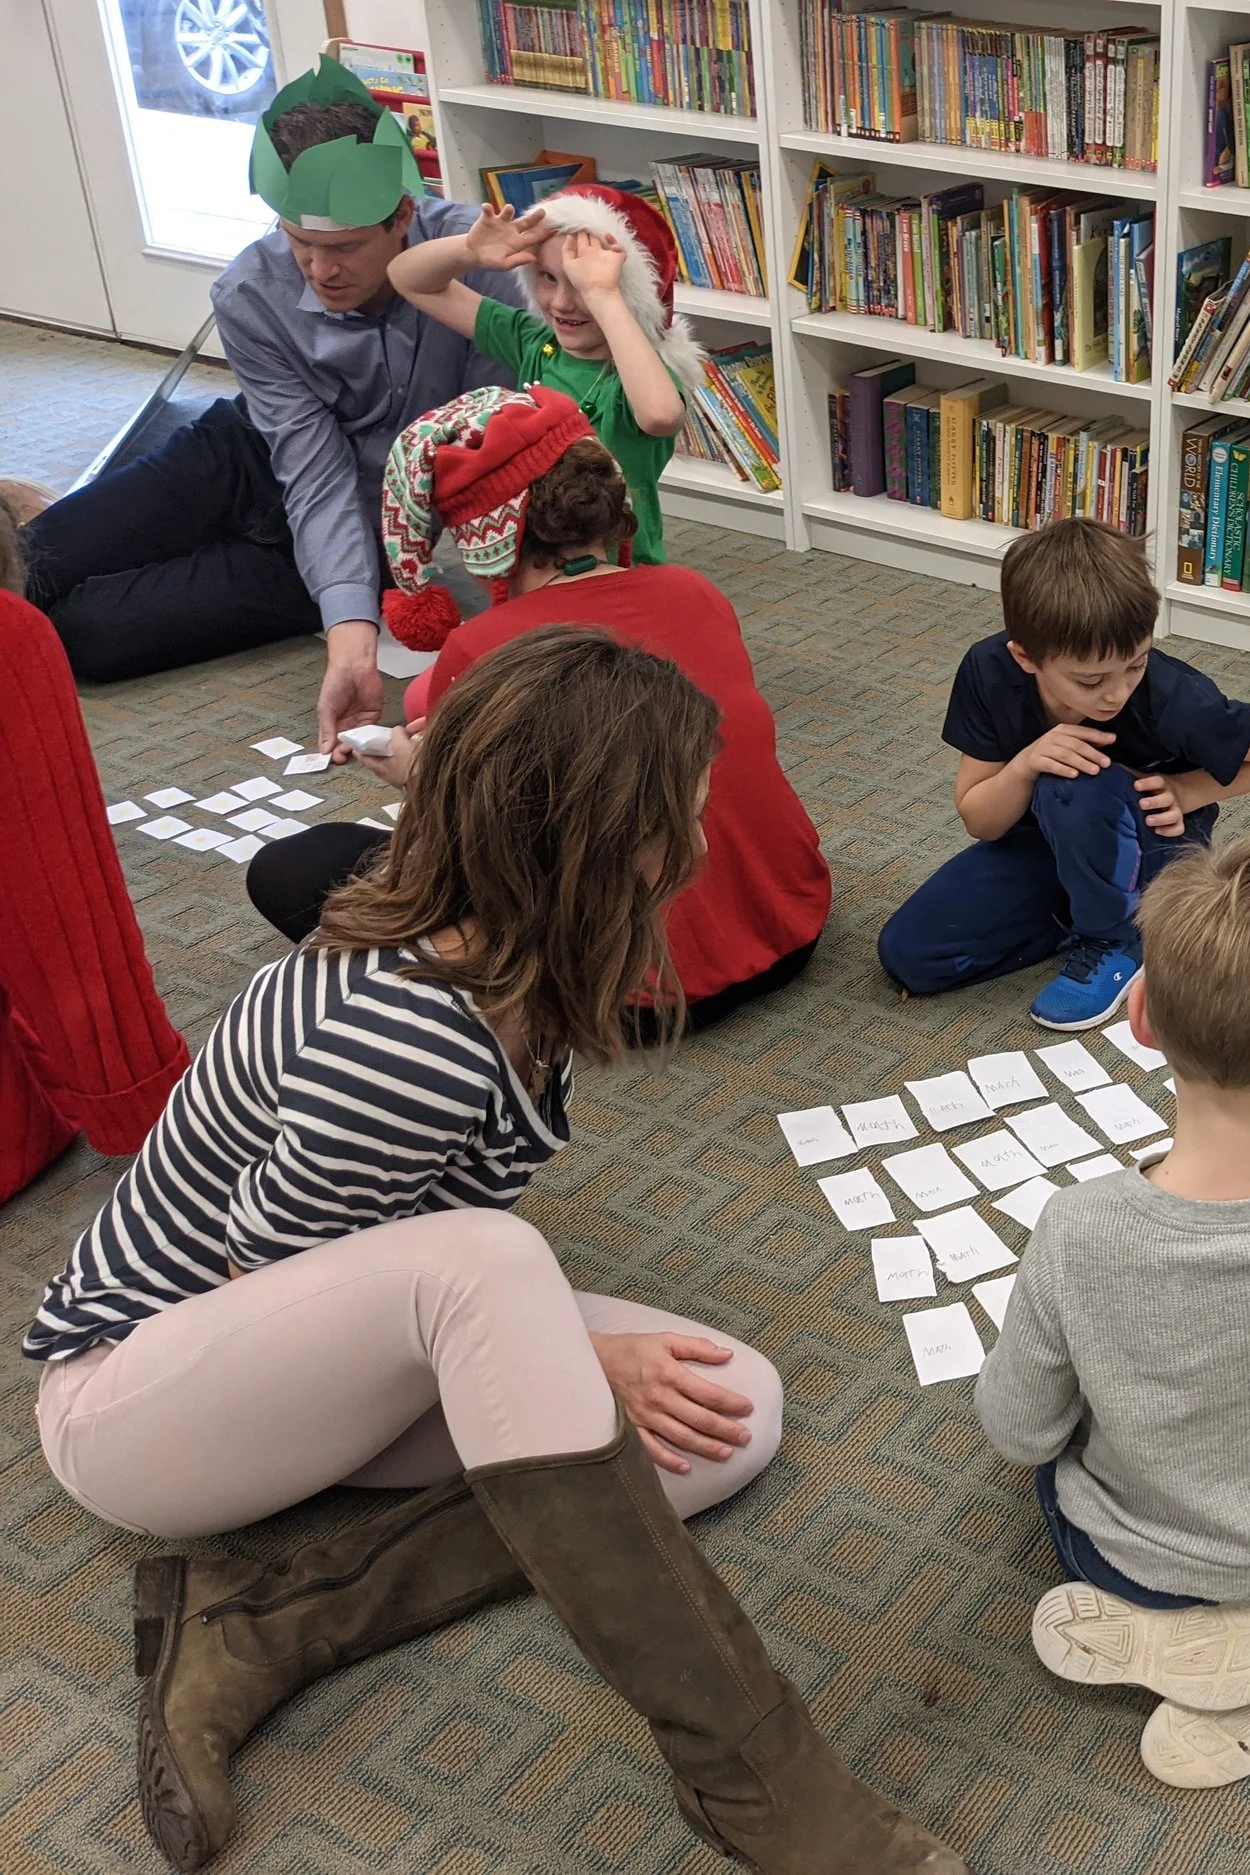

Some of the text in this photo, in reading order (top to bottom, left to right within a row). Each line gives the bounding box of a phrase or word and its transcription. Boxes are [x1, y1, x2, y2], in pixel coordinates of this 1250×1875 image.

[1182, 437, 1198, 488] WORLD
[1207, 465, 1223, 561] Elementary Dictionary
[1221, 462, 1240, 575] CHILDREN'S DICTIONARY
[1230, 491, 1245, 551] SCHOLASTIC
